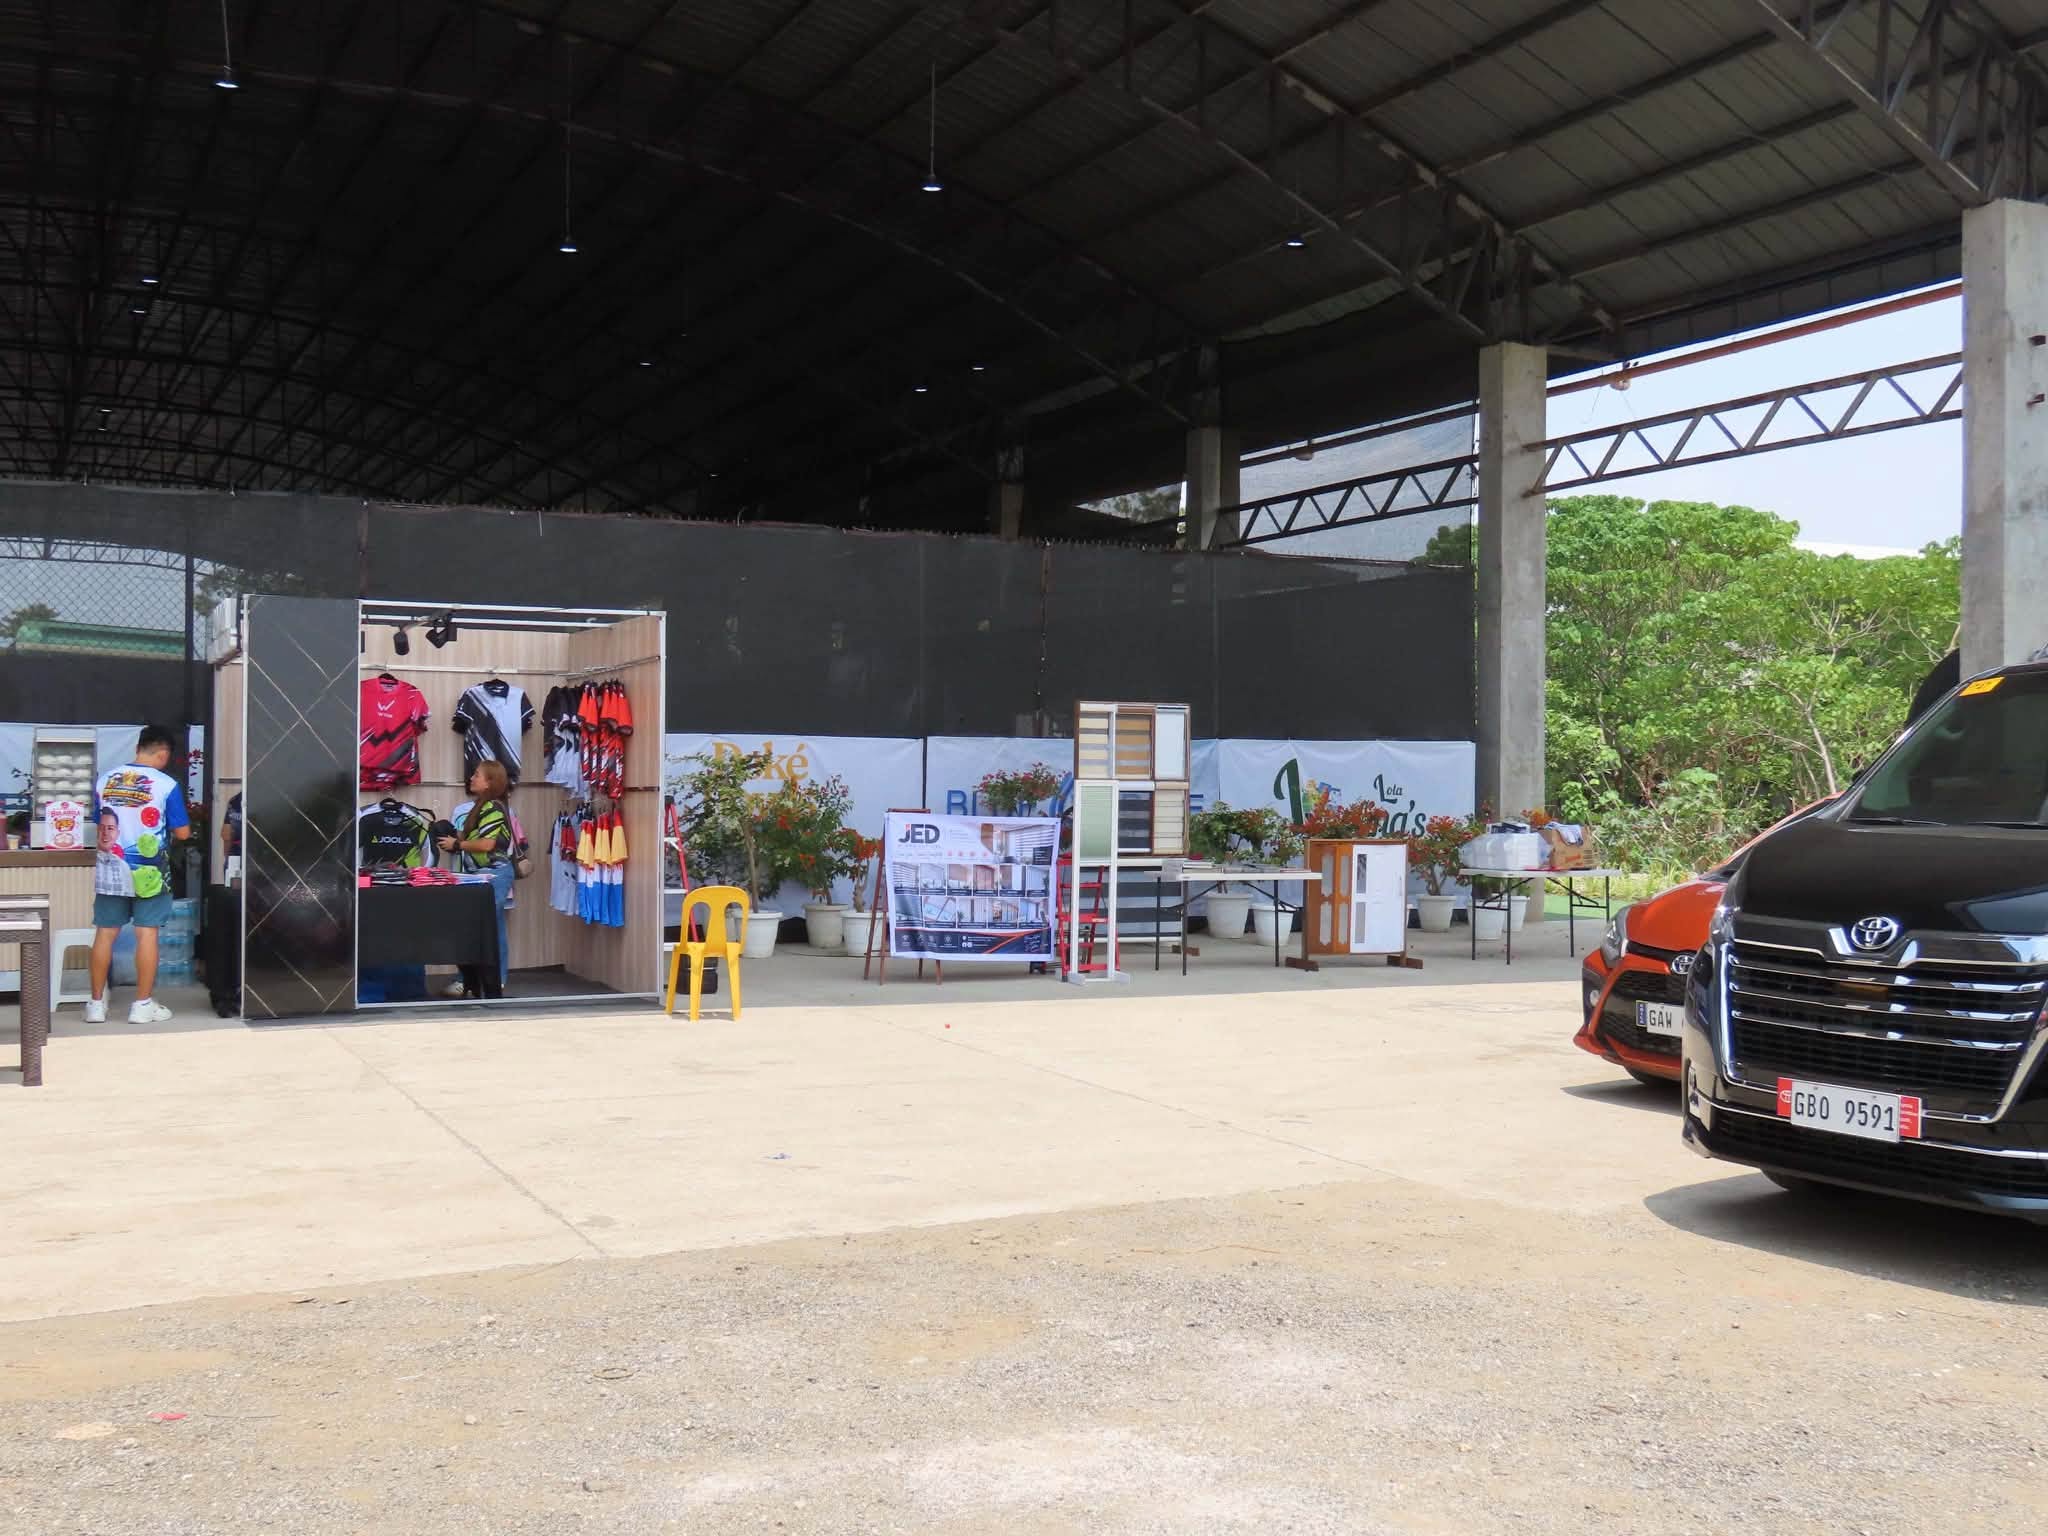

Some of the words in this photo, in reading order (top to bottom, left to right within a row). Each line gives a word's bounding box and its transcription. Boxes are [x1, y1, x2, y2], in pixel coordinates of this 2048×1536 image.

[1373, 774, 1403, 804] Lola
[898, 823, 940, 844] JED
[1649, 1009, 1672, 1029] GAW
[1794, 1092, 1829, 1120] GBO
[1845, 1100, 1894, 1131] 9591
